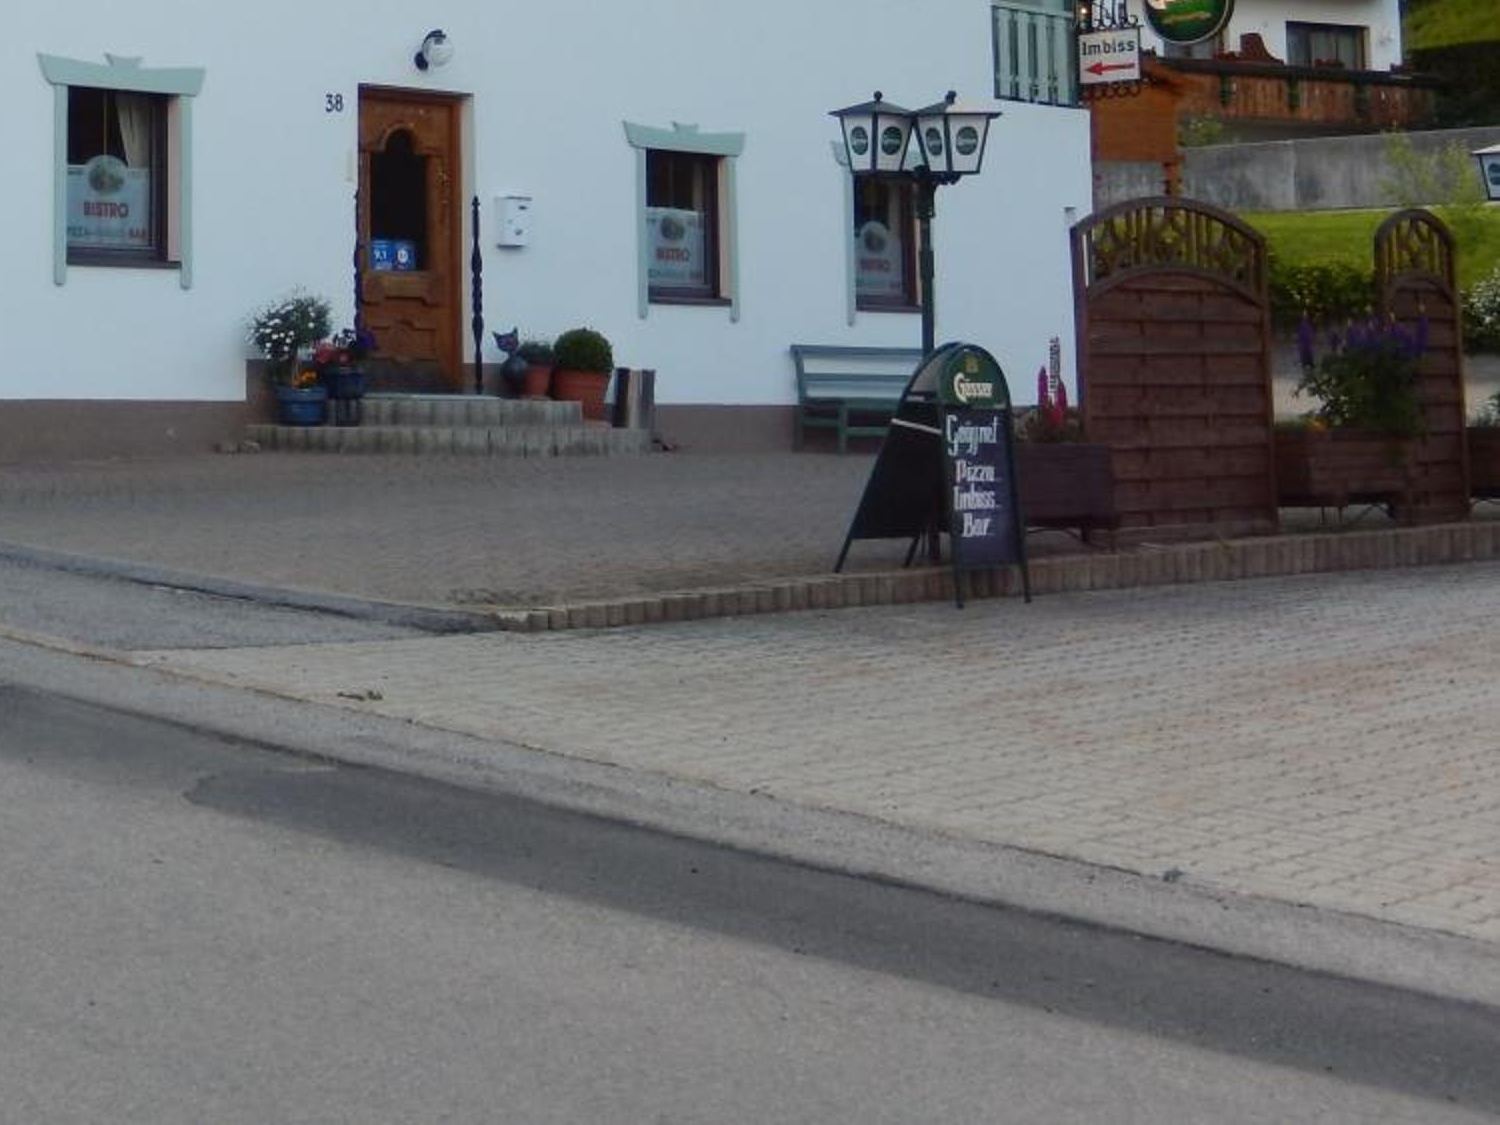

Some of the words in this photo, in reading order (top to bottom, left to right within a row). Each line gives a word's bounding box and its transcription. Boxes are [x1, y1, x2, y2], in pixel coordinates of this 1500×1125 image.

[1081, 41, 1136, 56] Imbiss
[325, 93, 344, 113] 38
[83, 201, 129, 219] BISTRO
